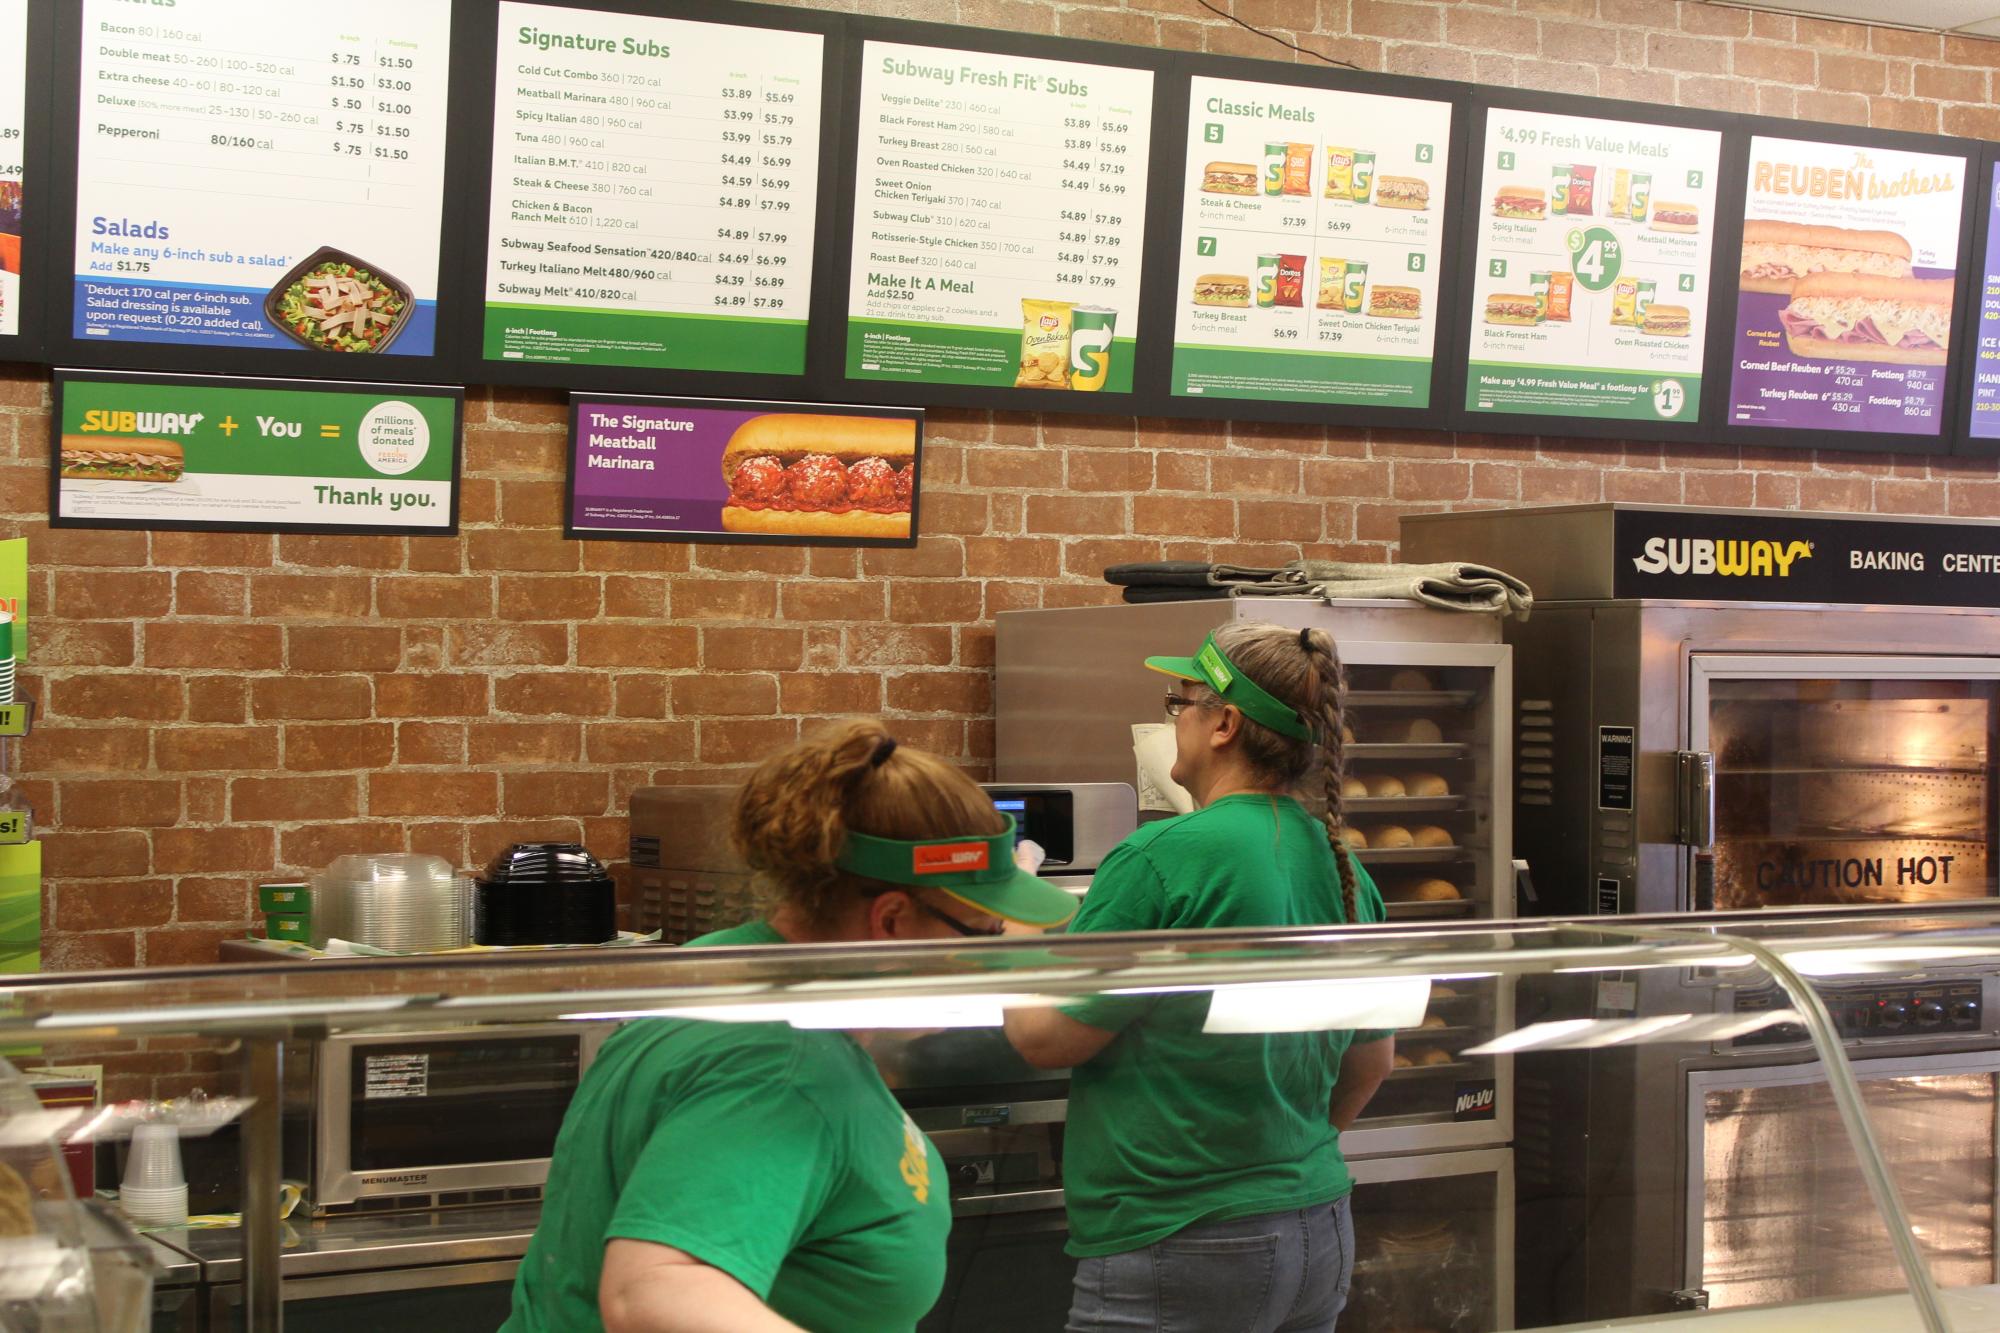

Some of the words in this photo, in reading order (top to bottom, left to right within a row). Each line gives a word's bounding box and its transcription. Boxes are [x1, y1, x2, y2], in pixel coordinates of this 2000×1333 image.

[101, 23, 135, 35] Bacon
[518, 27, 616, 53] Signature
[623, 38, 670, 58] Subs
[100, 47, 138, 60] Double
[143, 52, 170, 63] meat
[380, 57, 413, 69] $1.50
[98, 71, 128, 83] Extra
[132, 73, 170, 87] cheese
[518, 65, 541, 76] Cold
[543, 68, 561, 78] Cut
[564, 70, 598, 81] Combo
[882, 58, 954, 84] Subway
[960, 68, 1008, 88] Fresh
[1047, 77, 1088, 97] Subs
[331, 76, 364, 89] $1.50
[378, 79, 411, 92] $3.00
[722, 88, 751, 99] $3.89
[766, 92, 794, 104] $5.69
[378, 102, 411, 115] $1.00
[1207, 98, 1263, 118] Classic
[1268, 103, 1315, 122] Meals
[516, 110, 543, 122] Spicy
[546, 113, 577, 124] Italian
[880, 115, 904, 125] Black
[907, 118, 936, 129] Forest
[939, 120, 957, 131] Ham
[1064, 118, 1090, 129] $3.89
[1102, 122, 1128, 133] $5.69
[98, 124, 160, 140] Pepperoni
[211, 135, 254, 148] 80/160
[257, 138, 274, 150] cal
[515, 133, 538, 143] Tuna
[1209, 127, 1218, 140] 5
[1500, 127, 1537, 144] $4.99
[1541, 132, 1580, 149] Fresh
[1585, 136, 1624, 153] Value
[878, 136, 908, 148] Turkey
[911, 139, 939, 150] Breast
[722, 154, 751, 166] $4.49
[763, 156, 791, 167] $6.99
[1420, 148, 1428, 160] 6
[1852, 152, 1874, 169] The
[877, 157, 900, 167] Oven
[902, 159, 939, 171] Roasted
[941, 163, 974, 175] Chicken
[1502, 155, 1510, 167] 1
[513, 178, 542, 188] Steak
[545, 180, 551, 189] &
[554, 181, 589, 192] Cheese
[1691, 174, 1699, 185] 2
[1755, 162, 1863, 199] REUBEN
[1869, 169, 1955, 199] brothers
[512, 200, 550, 211] Chicken
[553, 203, 559, 211] &
[563, 204, 592, 213] Bacon
[1201, 198, 1223, 208] Steak
[1233, 201, 1261, 211] Cheese
[512, 212, 541, 223] Ranch
[545, 214, 567, 224] Melt
[1283, 217, 1306, 227] $7.39
[1328, 221, 1351, 232] $6.99
[92, 217, 169, 240] Salads
[501, 238, 544, 252] Subway
[547, 242, 591, 255] Seafood
[1202, 241, 1212, 253] 7
[91, 243, 129, 257] Make
[133, 247, 159, 262] any
[163, 247, 206, 263] 6-inch
[209, 252, 233, 265] sub
[718, 253, 749, 264] $4.69
[757, 255, 787, 266] $6.99
[870, 253, 896, 263] Roast
[899, 255, 919, 265] Beef
[90, 261, 112, 272] Add
[117, 260, 150, 272] $1.75
[1412, 257, 1420, 268] 8
[1494, 262, 1502, 274] 3
[500, 261, 537, 274] Turkey
[539, 264, 580, 276] Italiano
[583, 266, 607, 277] Melt
[608, 267, 655, 280] 480/960
[867, 273, 906, 289] Make
[911, 276, 921, 290] It
[926, 278, 935, 290] A
[940, 279, 974, 293] Meal
[1056, 273, 1083, 284] $4.89
[1089, 276, 1115, 287] $7.99
[1682, 278, 1690, 289] 4
[132, 286, 152, 298] 170
[155, 289, 170, 299] cal
[173, 291, 191, 303] per
[194, 290, 227, 303] 6-inch
[230, 293, 252, 305] sub.
[87, 297, 115, 309] Salad
[119, 299, 168, 315] dressing
[171, 304, 180, 313] is
[183, 304, 231, 316] available
[87, 312, 115, 325] upon
[118, 313, 162, 327] request
[165, 314, 204, 327] (0-220
[207, 316, 238, 329] added
[241, 318, 263, 331] cal).
[1193, 311, 1219, 322] Turkey
[1221, 312, 1247, 322] Breast
[1274, 329, 1298, 339] $6.99
[1319, 331, 1342, 341] $7.39
[1485, 330, 1504, 339] Black
[1507, 331, 1529, 340] Forest
[1531, 332, 1547, 340] Ham
[1982, 338, 1996, 348] ICE
[1741, 360, 1769, 370] Corned
[1771, 362, 1789, 372] Beef
[1792, 364, 1821, 373] Reuben
[1835, 377, 1850, 385] 470
[1852, 377, 1863, 386] cal
[1872, 370, 1904, 381] Footlong
[1481, 376, 1500, 385] Make
[1502, 378, 1515, 387] any
[1538, 379, 1557, 387] Fresh
[1559, 380, 1578, 389] Value
[1609, 382, 1638, 393] footlong
[1639, 384, 1648, 393] for
[1907, 381, 1922, 389] 940
[1923, 382, 1934, 390] cal
[1760, 389, 1785, 400] Turkey
[1788, 390, 1818, 400] Reuben
[1832, 403, 1847, 412] 430
[1849, 404, 1860, 412] cal
[1904, 407, 1919, 416] 860
[1921, 408, 1931, 416] cal
[81, 410, 205, 435] SUBWAY
[256, 416, 302, 438] You
[375, 416, 414, 425] millions
[590, 414, 618, 428] The
[622, 416, 694, 432] Signature
[371, 426, 382, 434] of
[373, 437, 414, 445] donated
[589, 434, 656, 450] Meatball
[588, 455, 654, 470] Marinara
[314, 486, 382, 505] Thank
[390, 490, 436, 511] you.
[1632, 537, 1813, 577] SUBWAY
[1850, 550, 1924, 571] BAKING
[1601, 734, 1631, 744] WARNING
[1756, 858, 1882, 890] CAUTION
[1898, 857, 1954, 885] HOT
[362, 1174, 427, 1184] MENUMASTER
